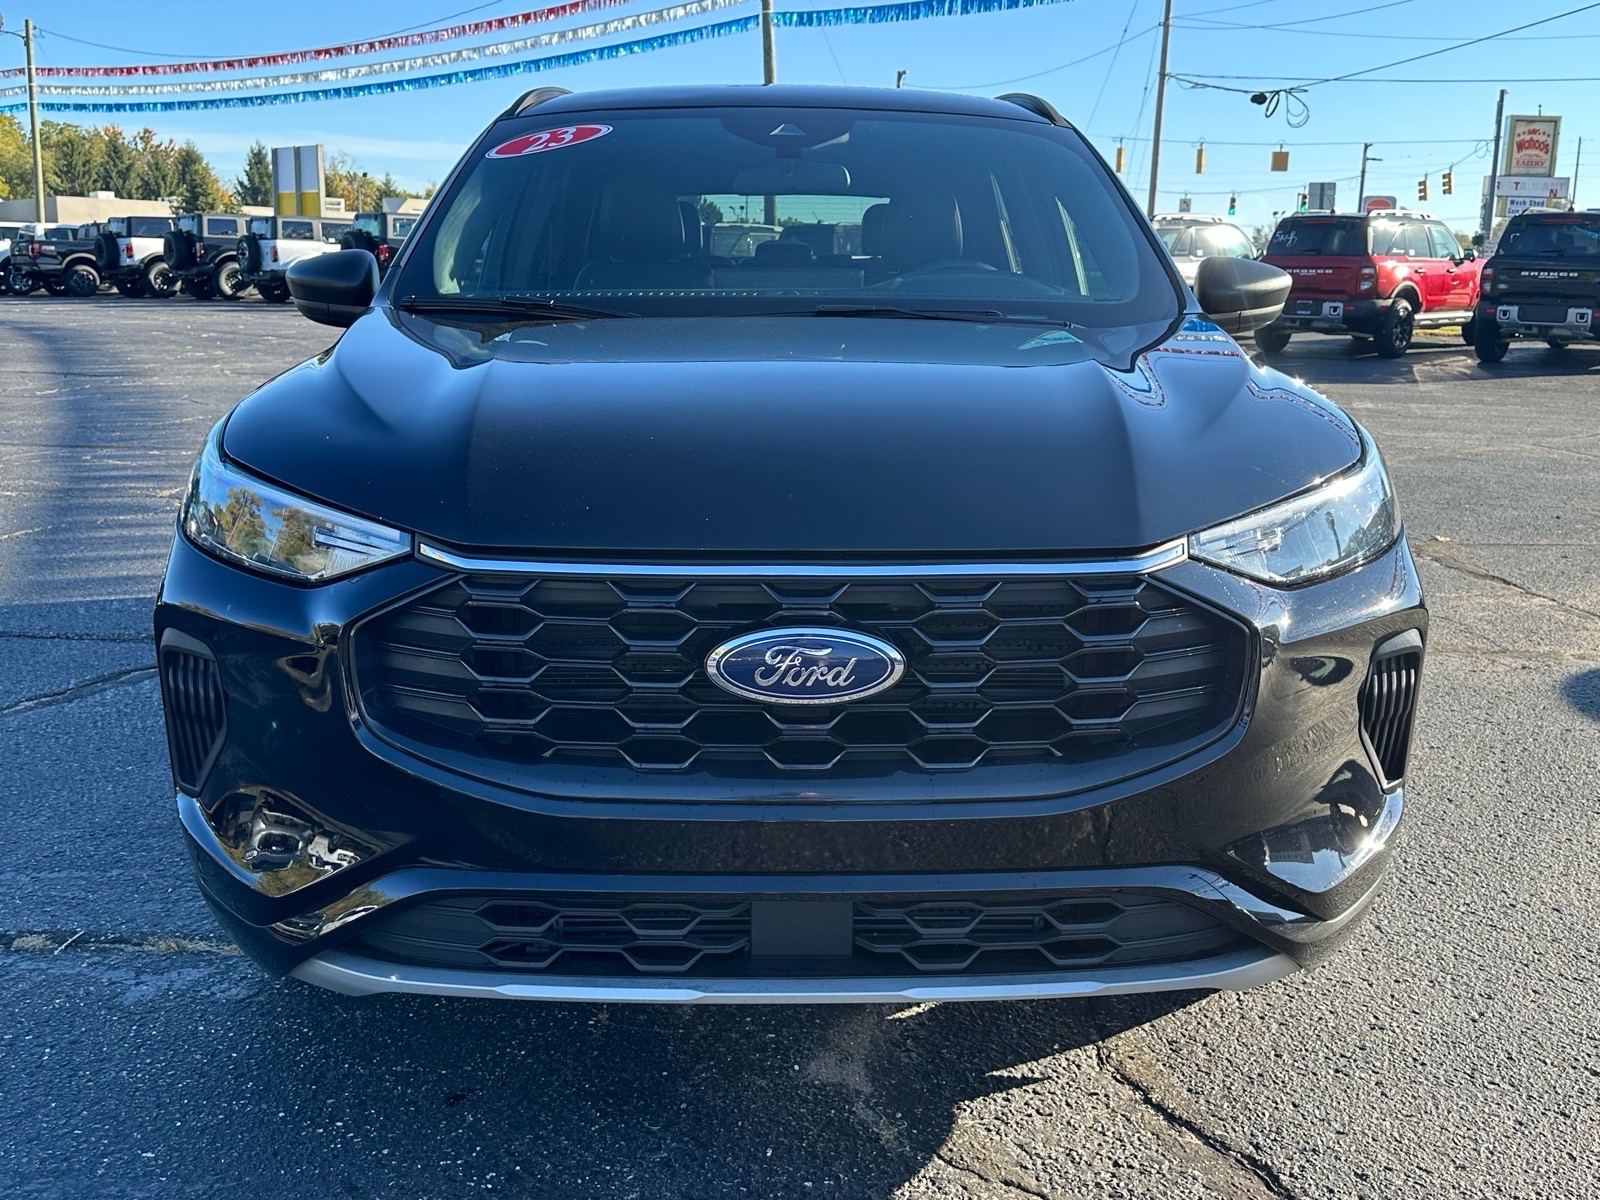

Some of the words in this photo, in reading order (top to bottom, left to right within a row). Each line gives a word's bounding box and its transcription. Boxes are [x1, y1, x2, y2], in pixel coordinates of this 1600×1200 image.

[521, 127, 577, 153] 23
[1516, 136, 1550, 155] Wahoo's
[754, 645, 858, 687] Ford
